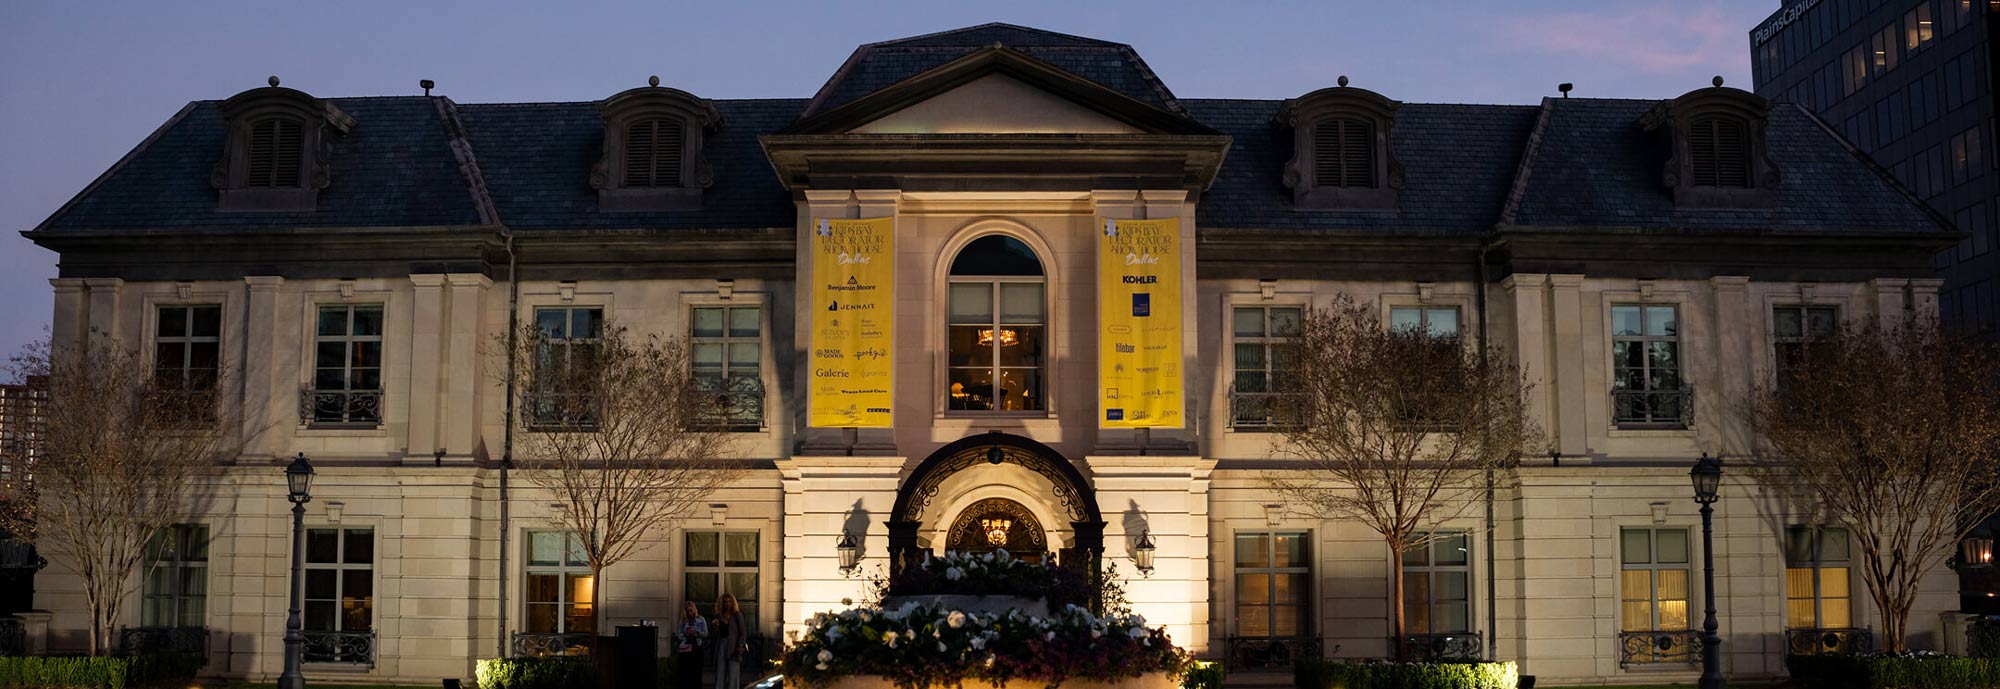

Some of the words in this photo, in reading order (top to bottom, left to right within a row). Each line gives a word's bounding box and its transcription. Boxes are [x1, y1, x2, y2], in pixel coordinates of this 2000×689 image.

[837, 252, 871, 265] Dallas
[1125, 252, 1159, 265] Dallas
[1122, 275, 1157, 284] KOHLER
[816, 368, 850, 378] Galerie
